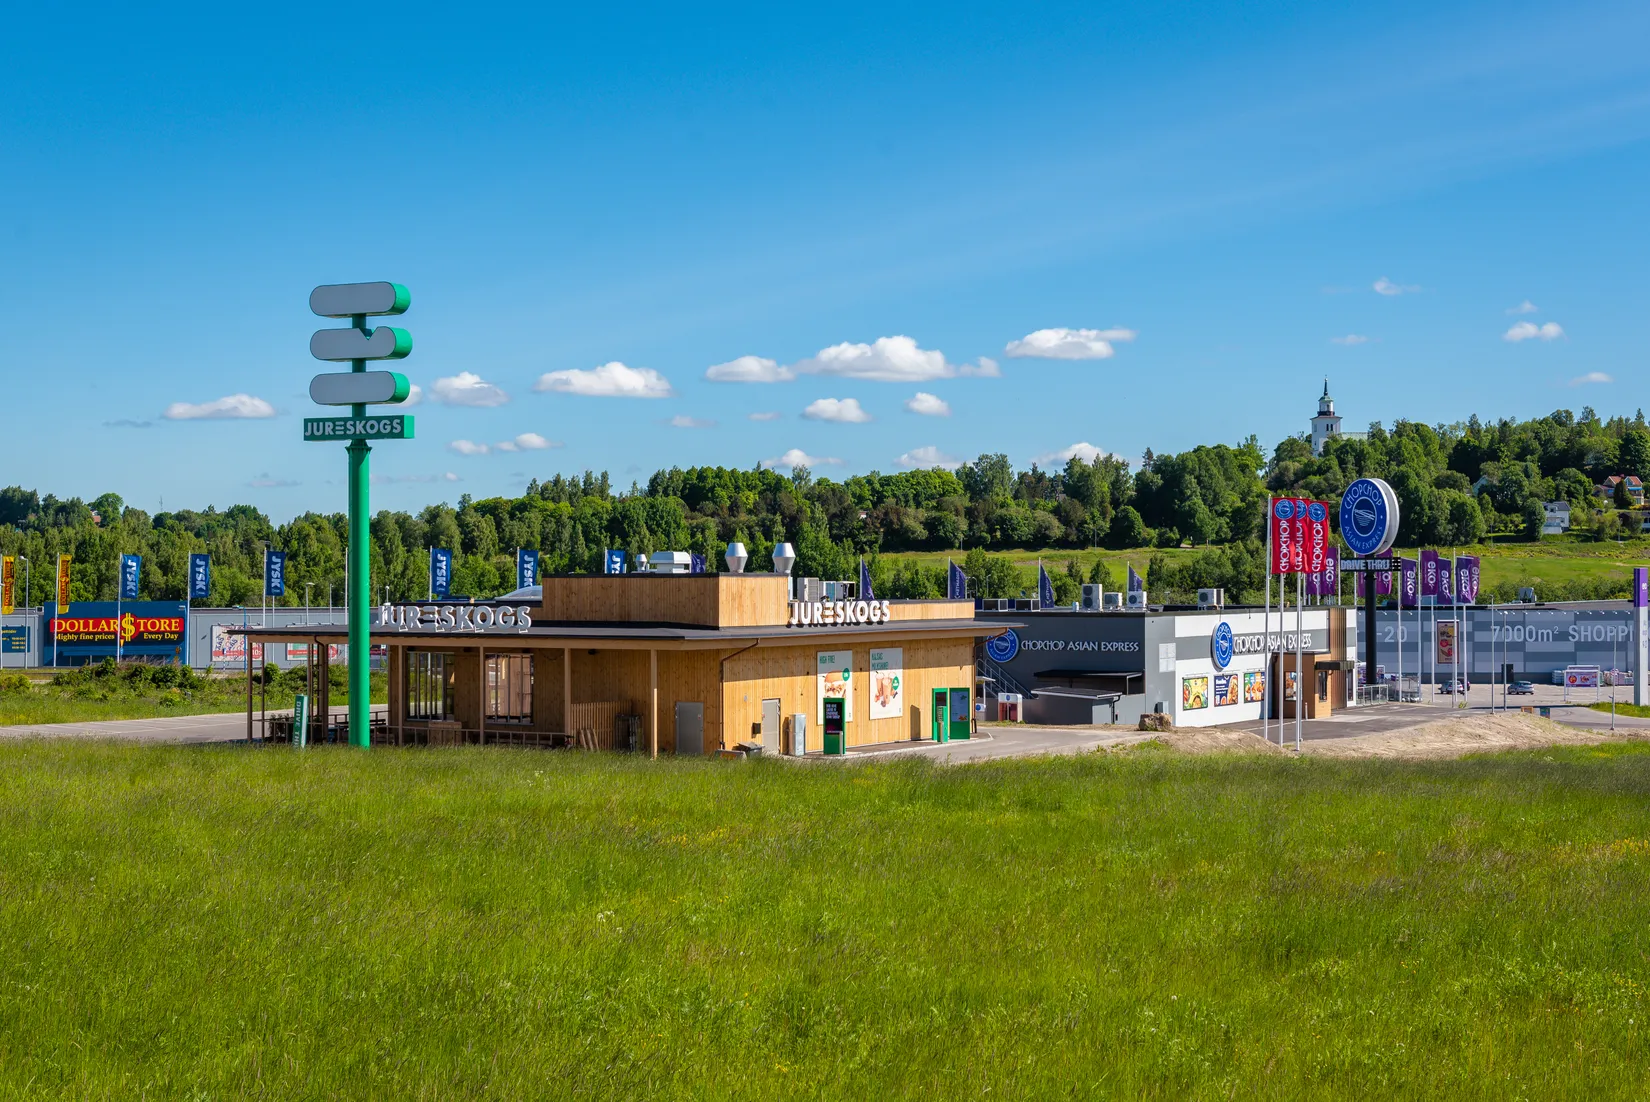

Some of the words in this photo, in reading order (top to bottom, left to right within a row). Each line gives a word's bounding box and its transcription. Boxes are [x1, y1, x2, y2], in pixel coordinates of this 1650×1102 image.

[305, 419, 402, 436] JURESKOGS
[1344, 483, 1383, 509] CHOPCHOP
[1279, 521, 1290, 571] CHOPCHOP
[1312, 523, 1323, 572] CHOPCHOP
[1345, 526, 1361, 548] ASIAN
[127, 559, 137, 591] JYSK
[195, 558, 206, 591] JYSK
[271, 555, 282, 588] JYSK
[437, 553, 447, 587] JYSK
[523, 554, 534, 587] JYSK
[1340, 559, 1366, 570] DRIVE
[1367, 559, 1390, 570] THRU
[375, 605, 532, 629] JURESKOGS
[791, 600, 890, 625] JURESKOGS
[95, 633, 115, 641] prices
[144, 632, 163, 640] Every
[165, 632, 178, 640] Day
[1021, 640, 1065, 651] CHOPCHOP
[1067, 641, 1098, 651] ASIAN
[1101, 642, 1139, 652] EXPRESS
[1568, 625, 1634, 642] SHOPPI
